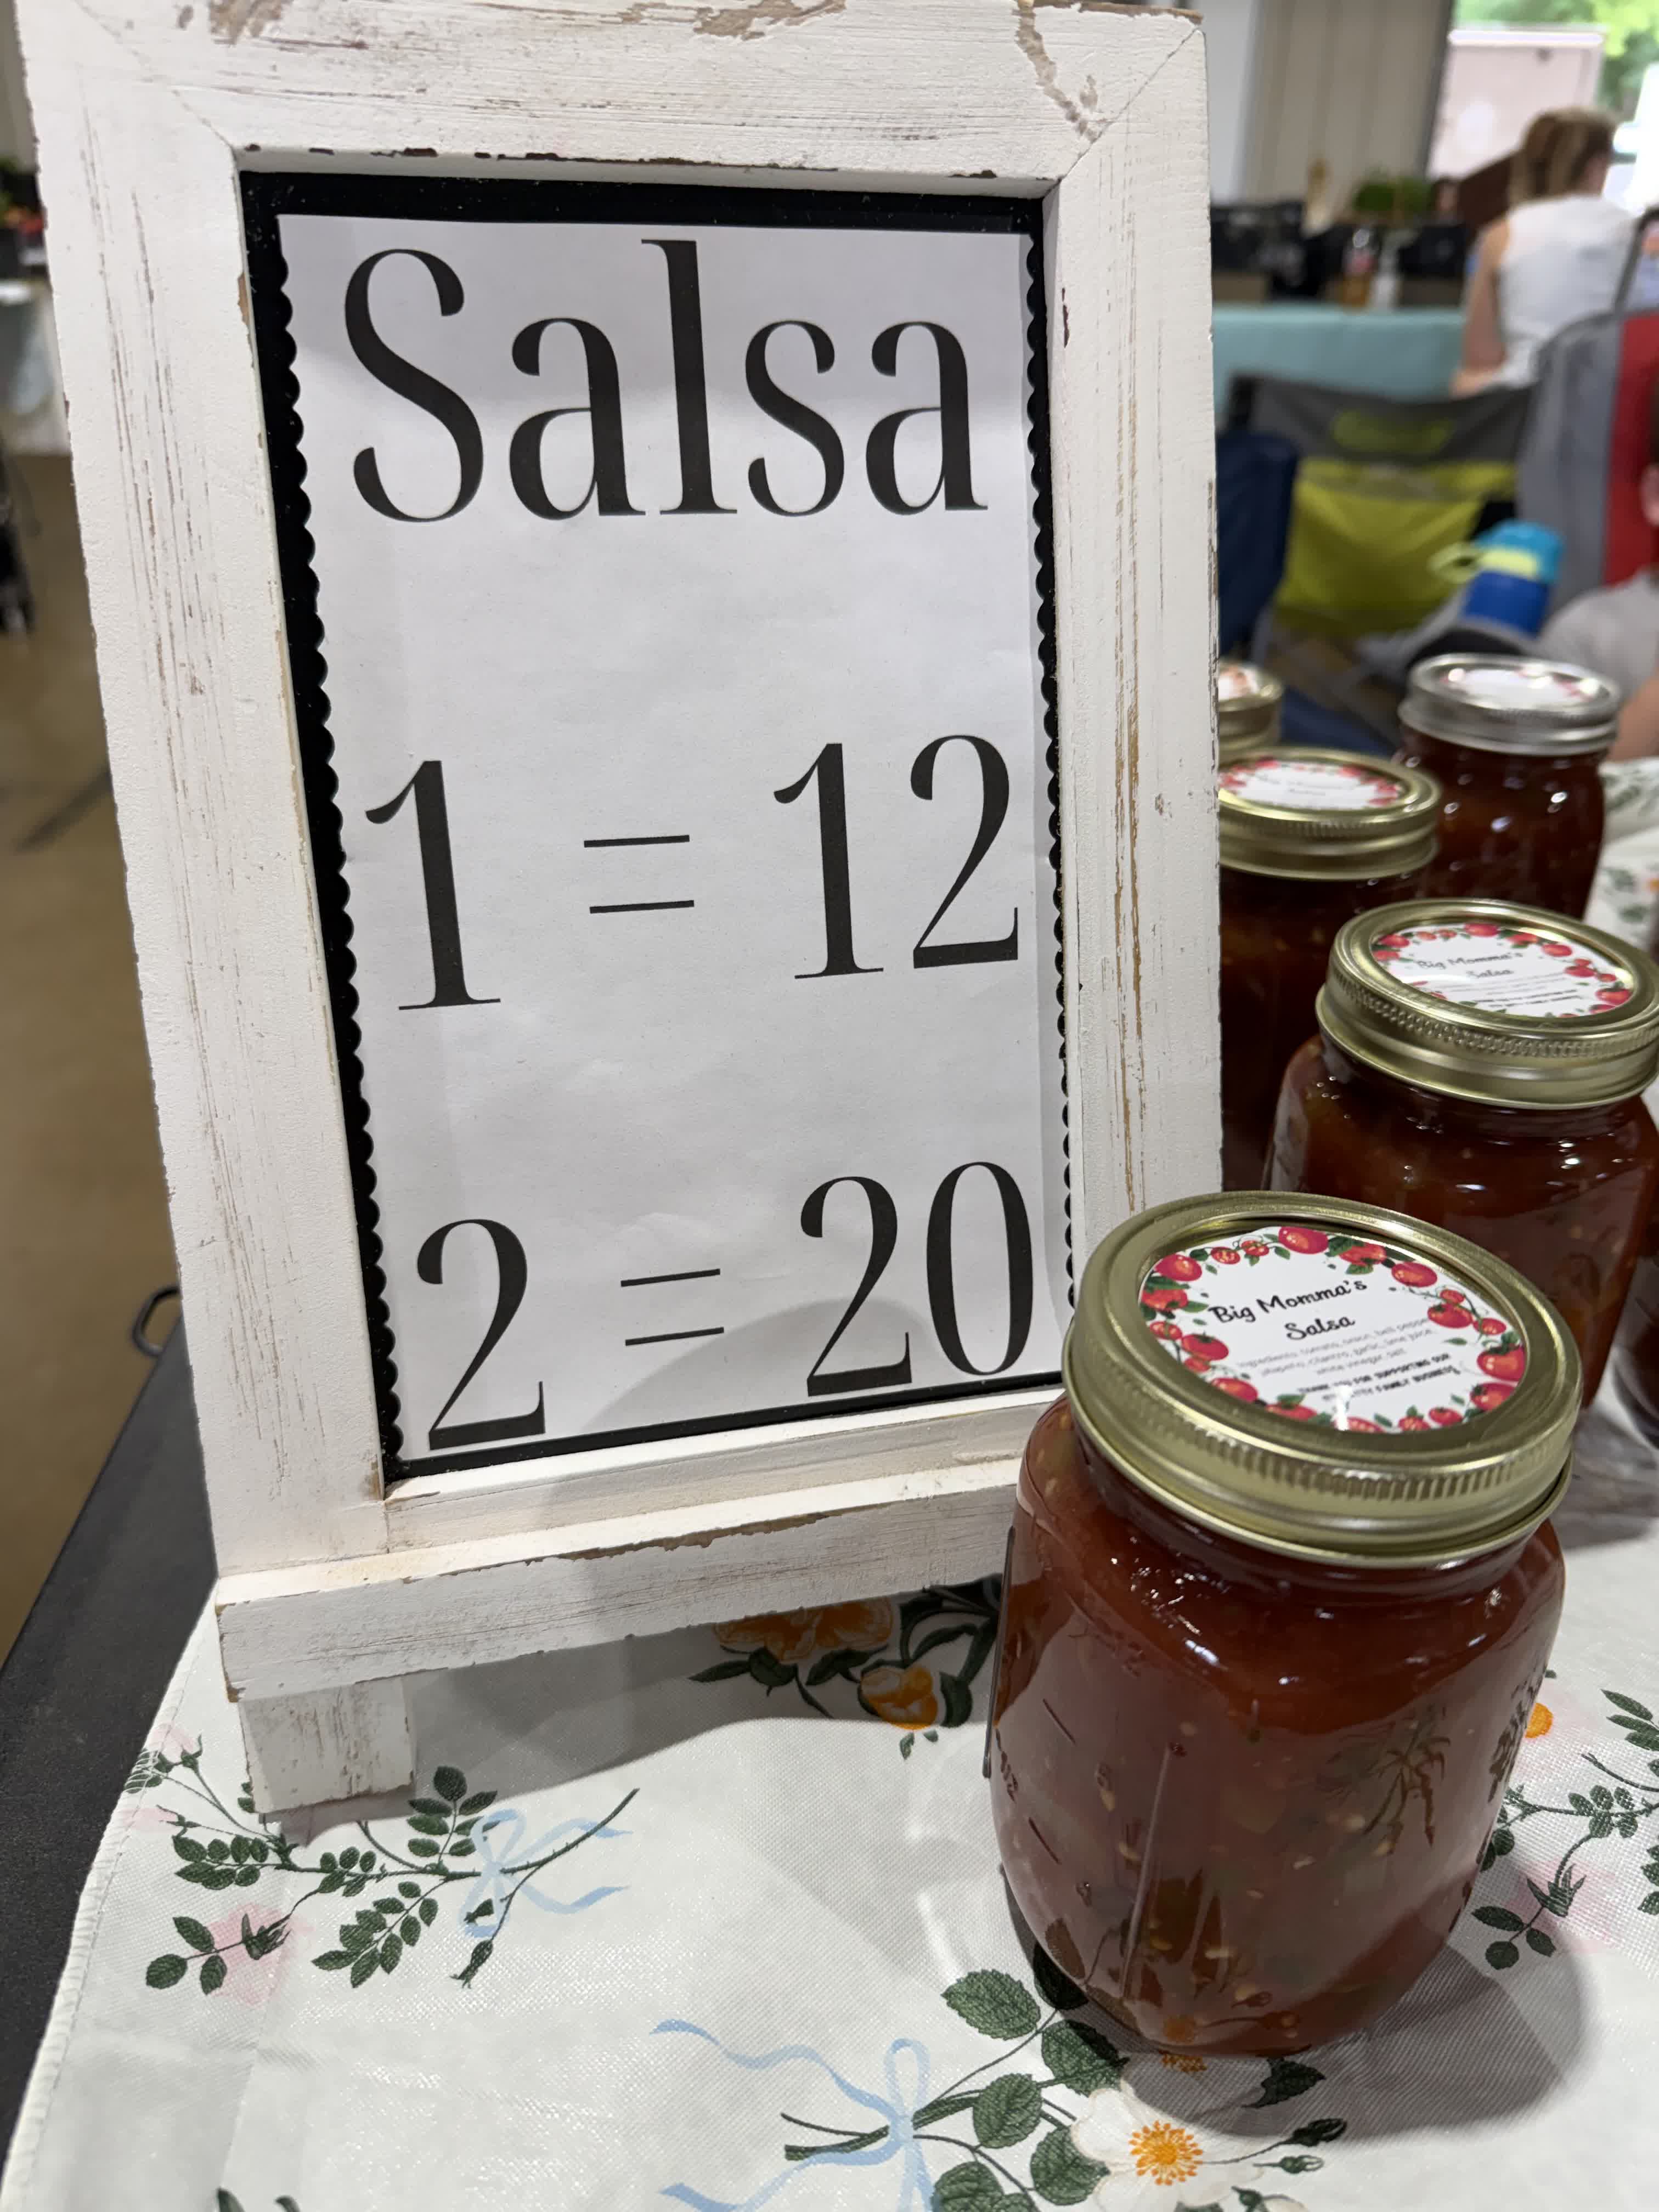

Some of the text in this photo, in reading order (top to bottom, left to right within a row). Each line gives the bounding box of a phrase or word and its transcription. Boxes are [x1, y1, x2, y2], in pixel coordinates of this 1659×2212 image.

[345, 240, 988, 522] Salsa
[366, 735, 1019, 1011] 1 = 12
[417, 1161, 1034, 1449] 2 = 20
[1207, 1280, 1368, 1323] Big Momma's
[1284, 1316, 1356, 1340] Salsa
